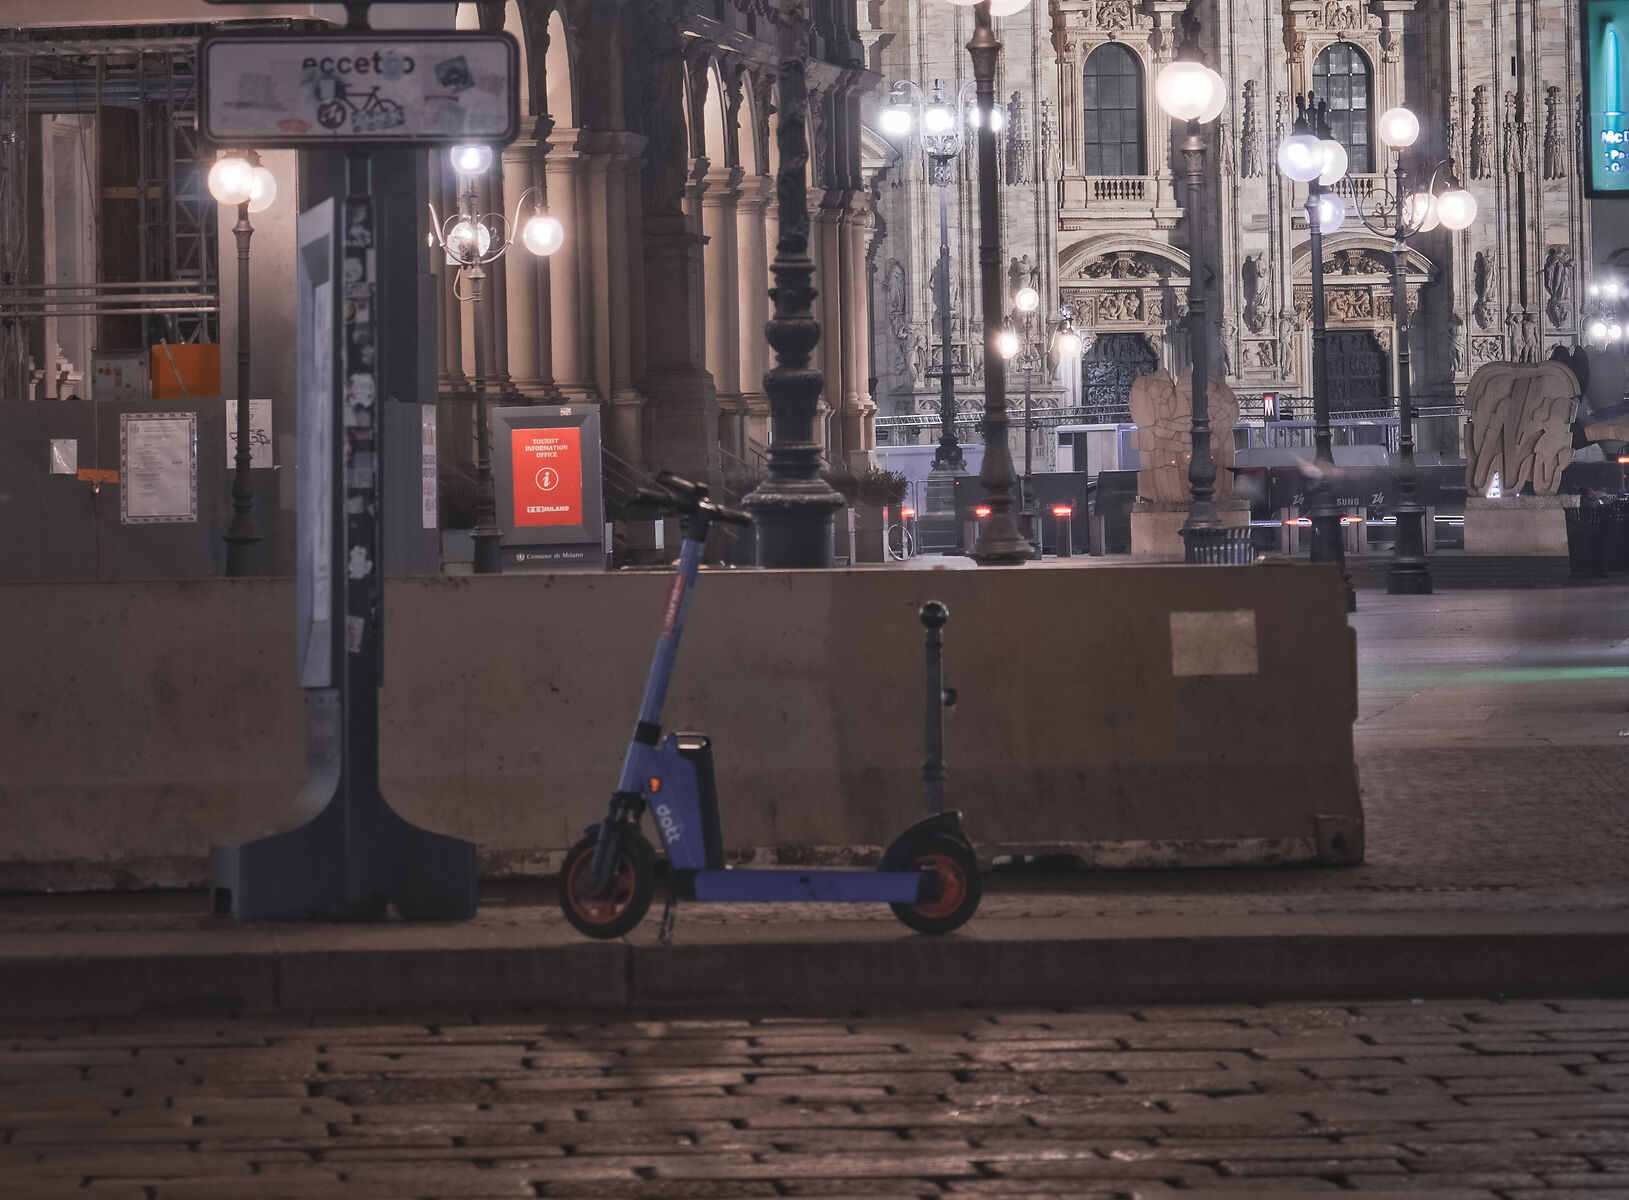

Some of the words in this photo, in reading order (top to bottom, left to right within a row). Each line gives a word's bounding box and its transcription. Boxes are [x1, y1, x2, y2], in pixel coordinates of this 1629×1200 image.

[302, 51, 415, 74] ecceto
[525, 444, 568, 452] INFORMATION
[656, 804, 681, 844] dott
